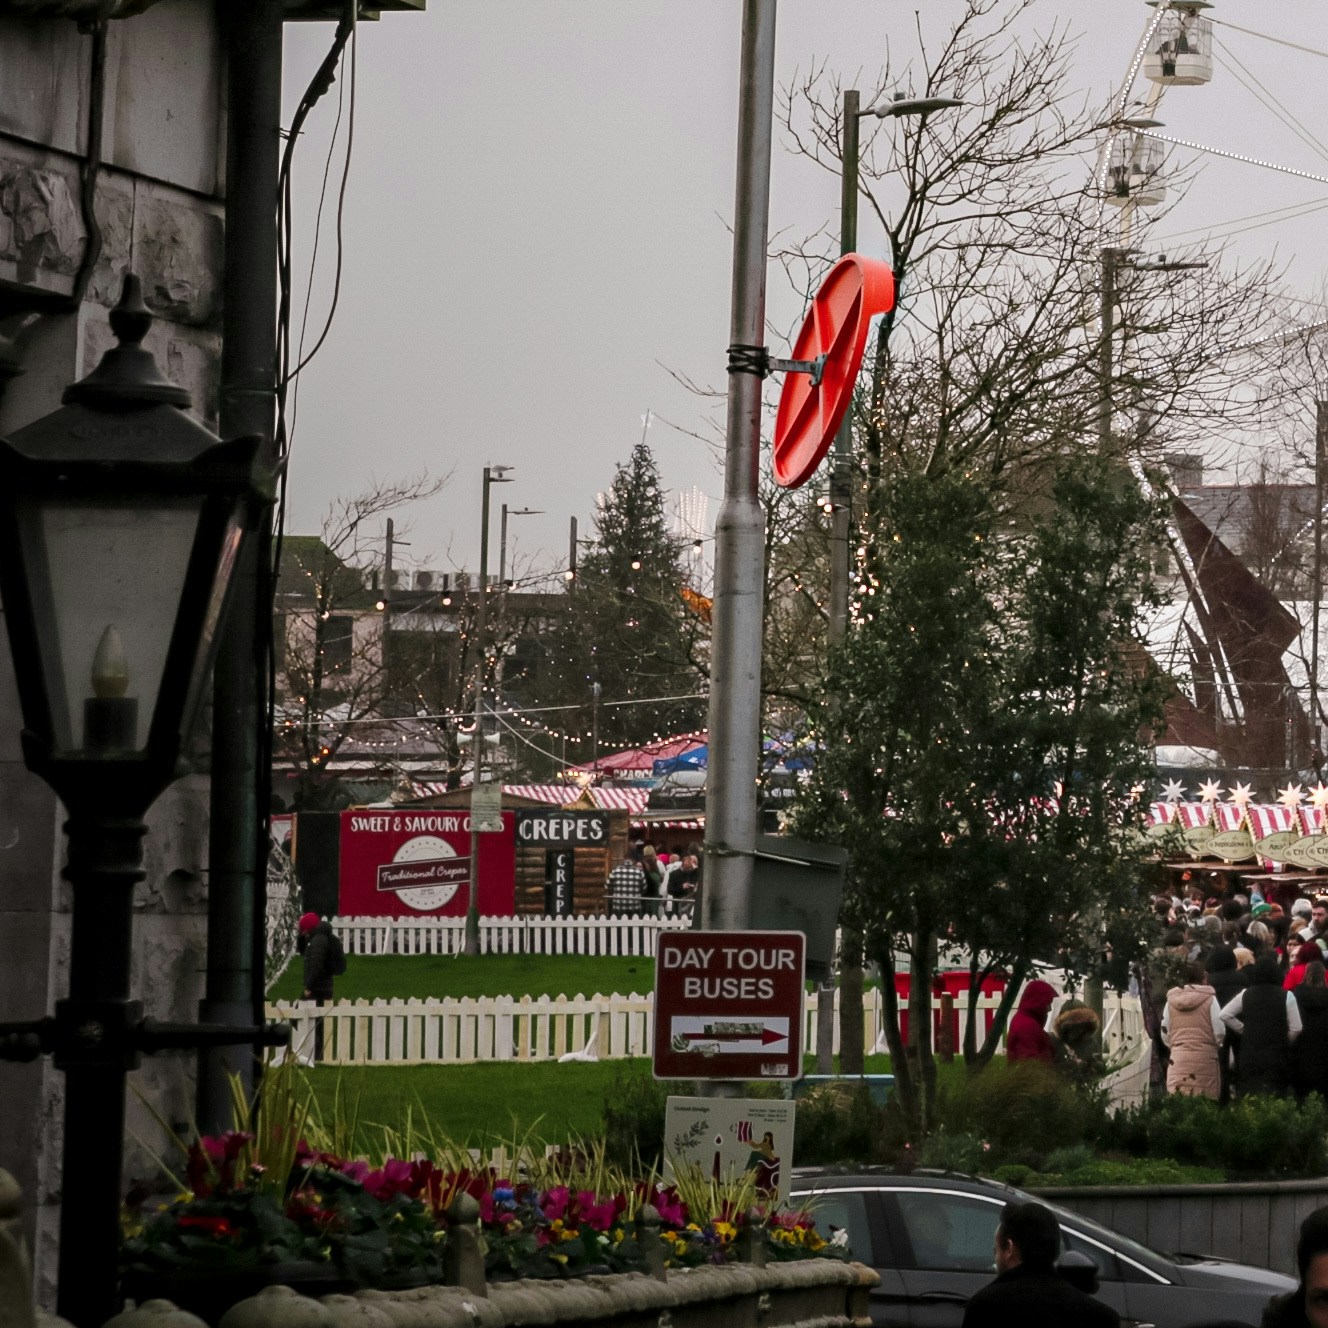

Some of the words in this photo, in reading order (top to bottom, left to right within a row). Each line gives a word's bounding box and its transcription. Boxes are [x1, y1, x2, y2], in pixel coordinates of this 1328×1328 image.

[351, 816, 389, 832] SWEET
[394, 816, 400, 832] &
[405, 816, 461, 833] SAVOURY
[519, 818, 603, 840] CREPES
[381, 865, 435, 882] Traditional
[437, 865, 468, 879] Crepes
[664, 947, 715, 969] DAY
[722, 948, 795, 970] TOUR
[684, 977, 774, 1000] BUSES
